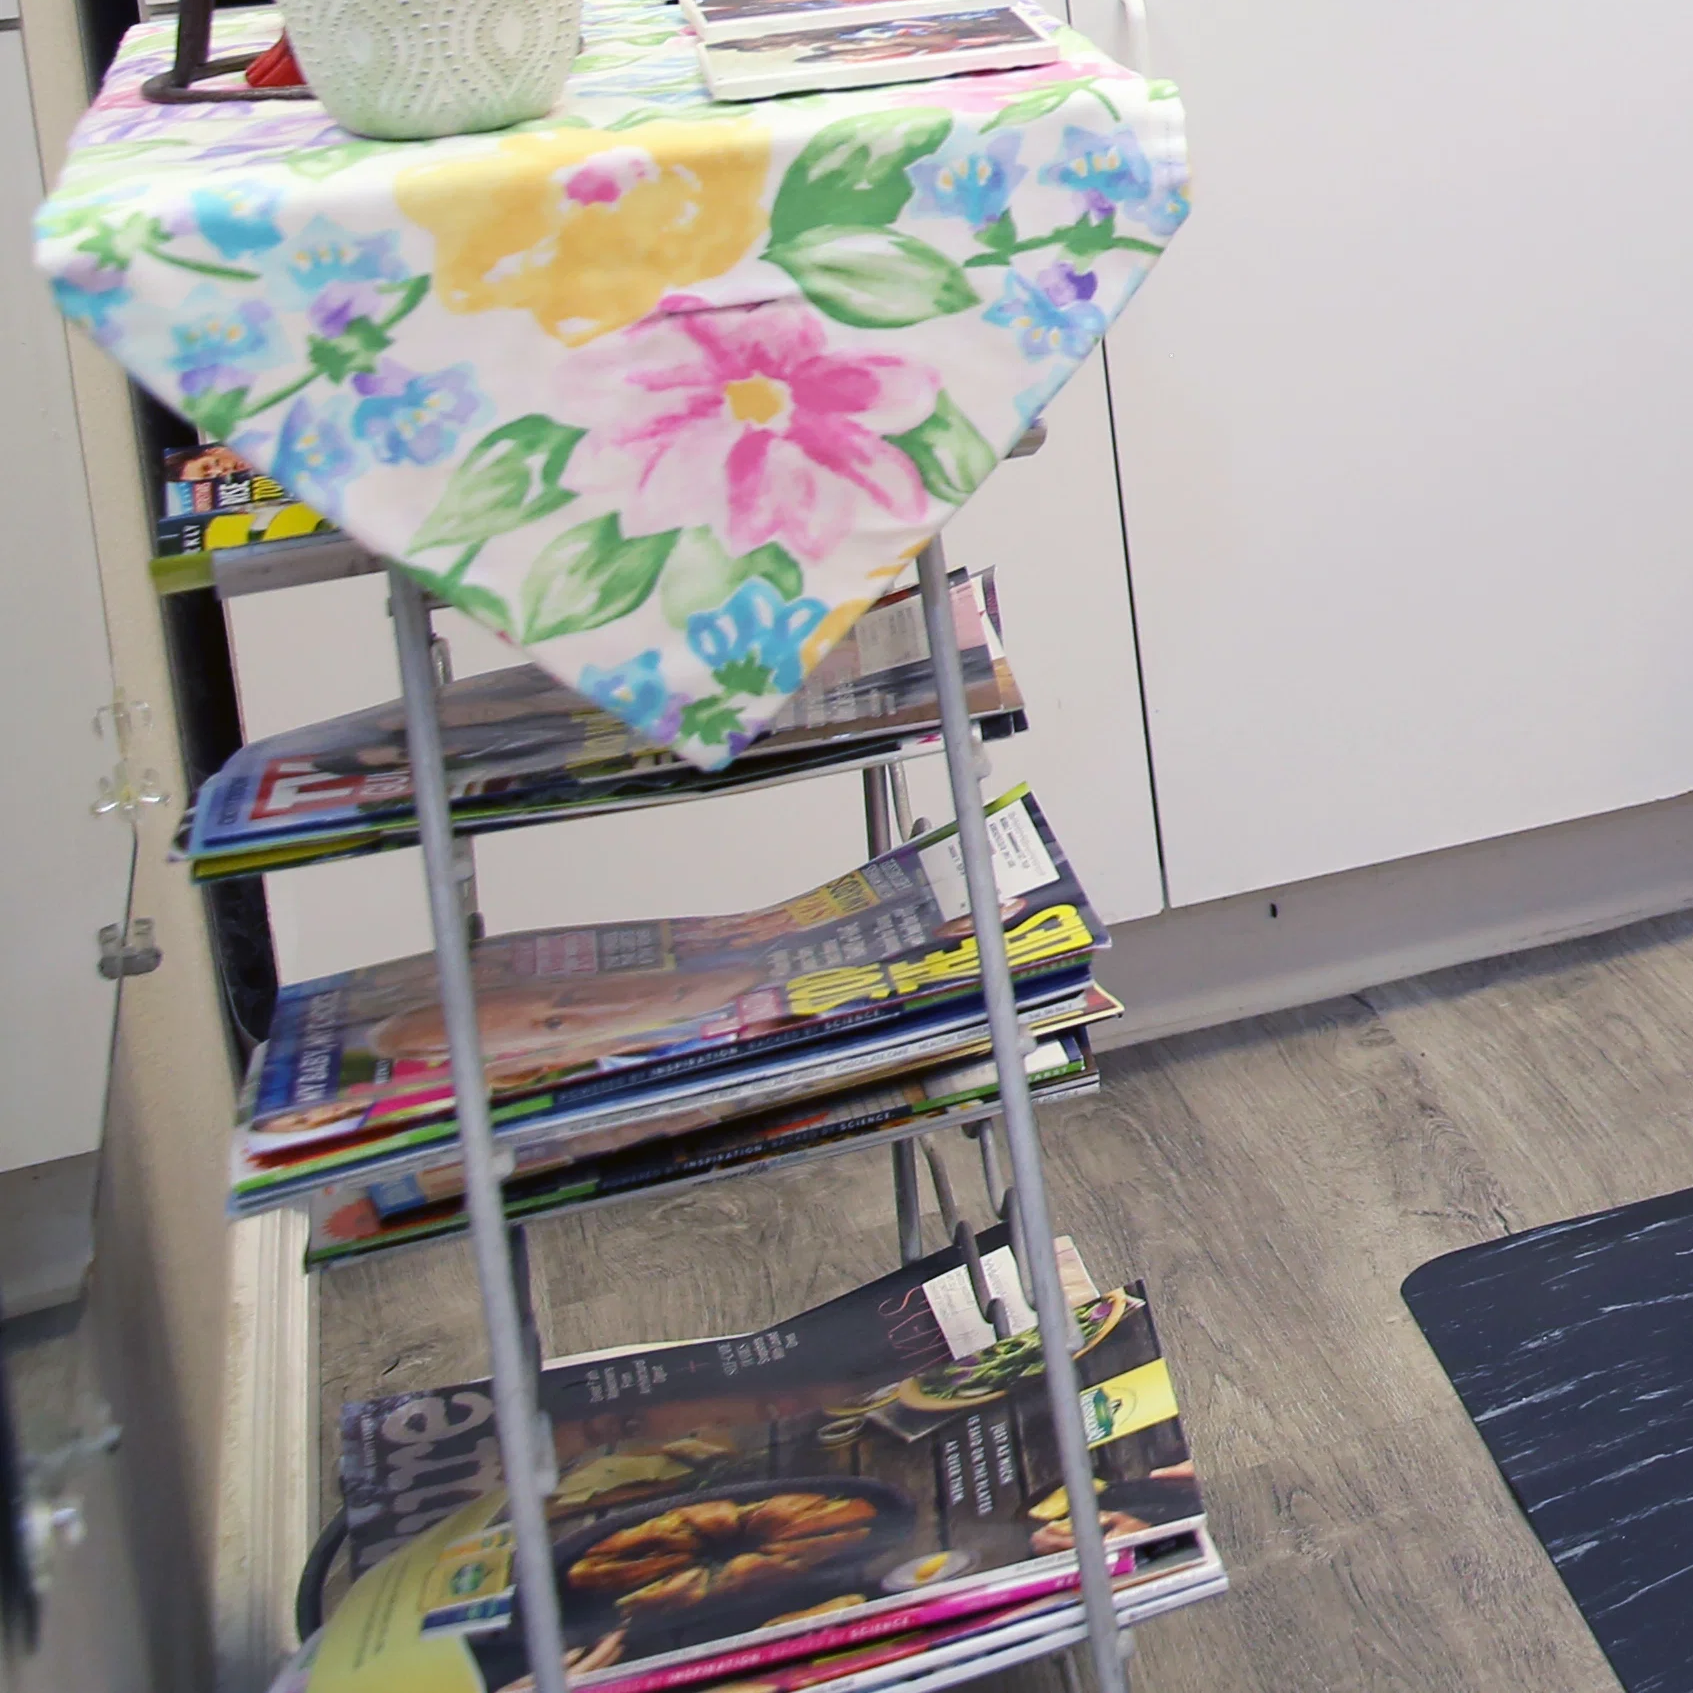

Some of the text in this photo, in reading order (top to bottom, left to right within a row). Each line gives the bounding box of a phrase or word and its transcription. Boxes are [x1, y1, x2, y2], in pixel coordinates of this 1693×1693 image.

[1005, 903, 1094, 968] LIES
[889, 935, 981, 996] THE
[683, 1144, 768, 1169] INSPIRATION.
[839, 1111, 896, 1132] SCIENCE.
[851, 1615, 916, 1640] SCIENCE.
